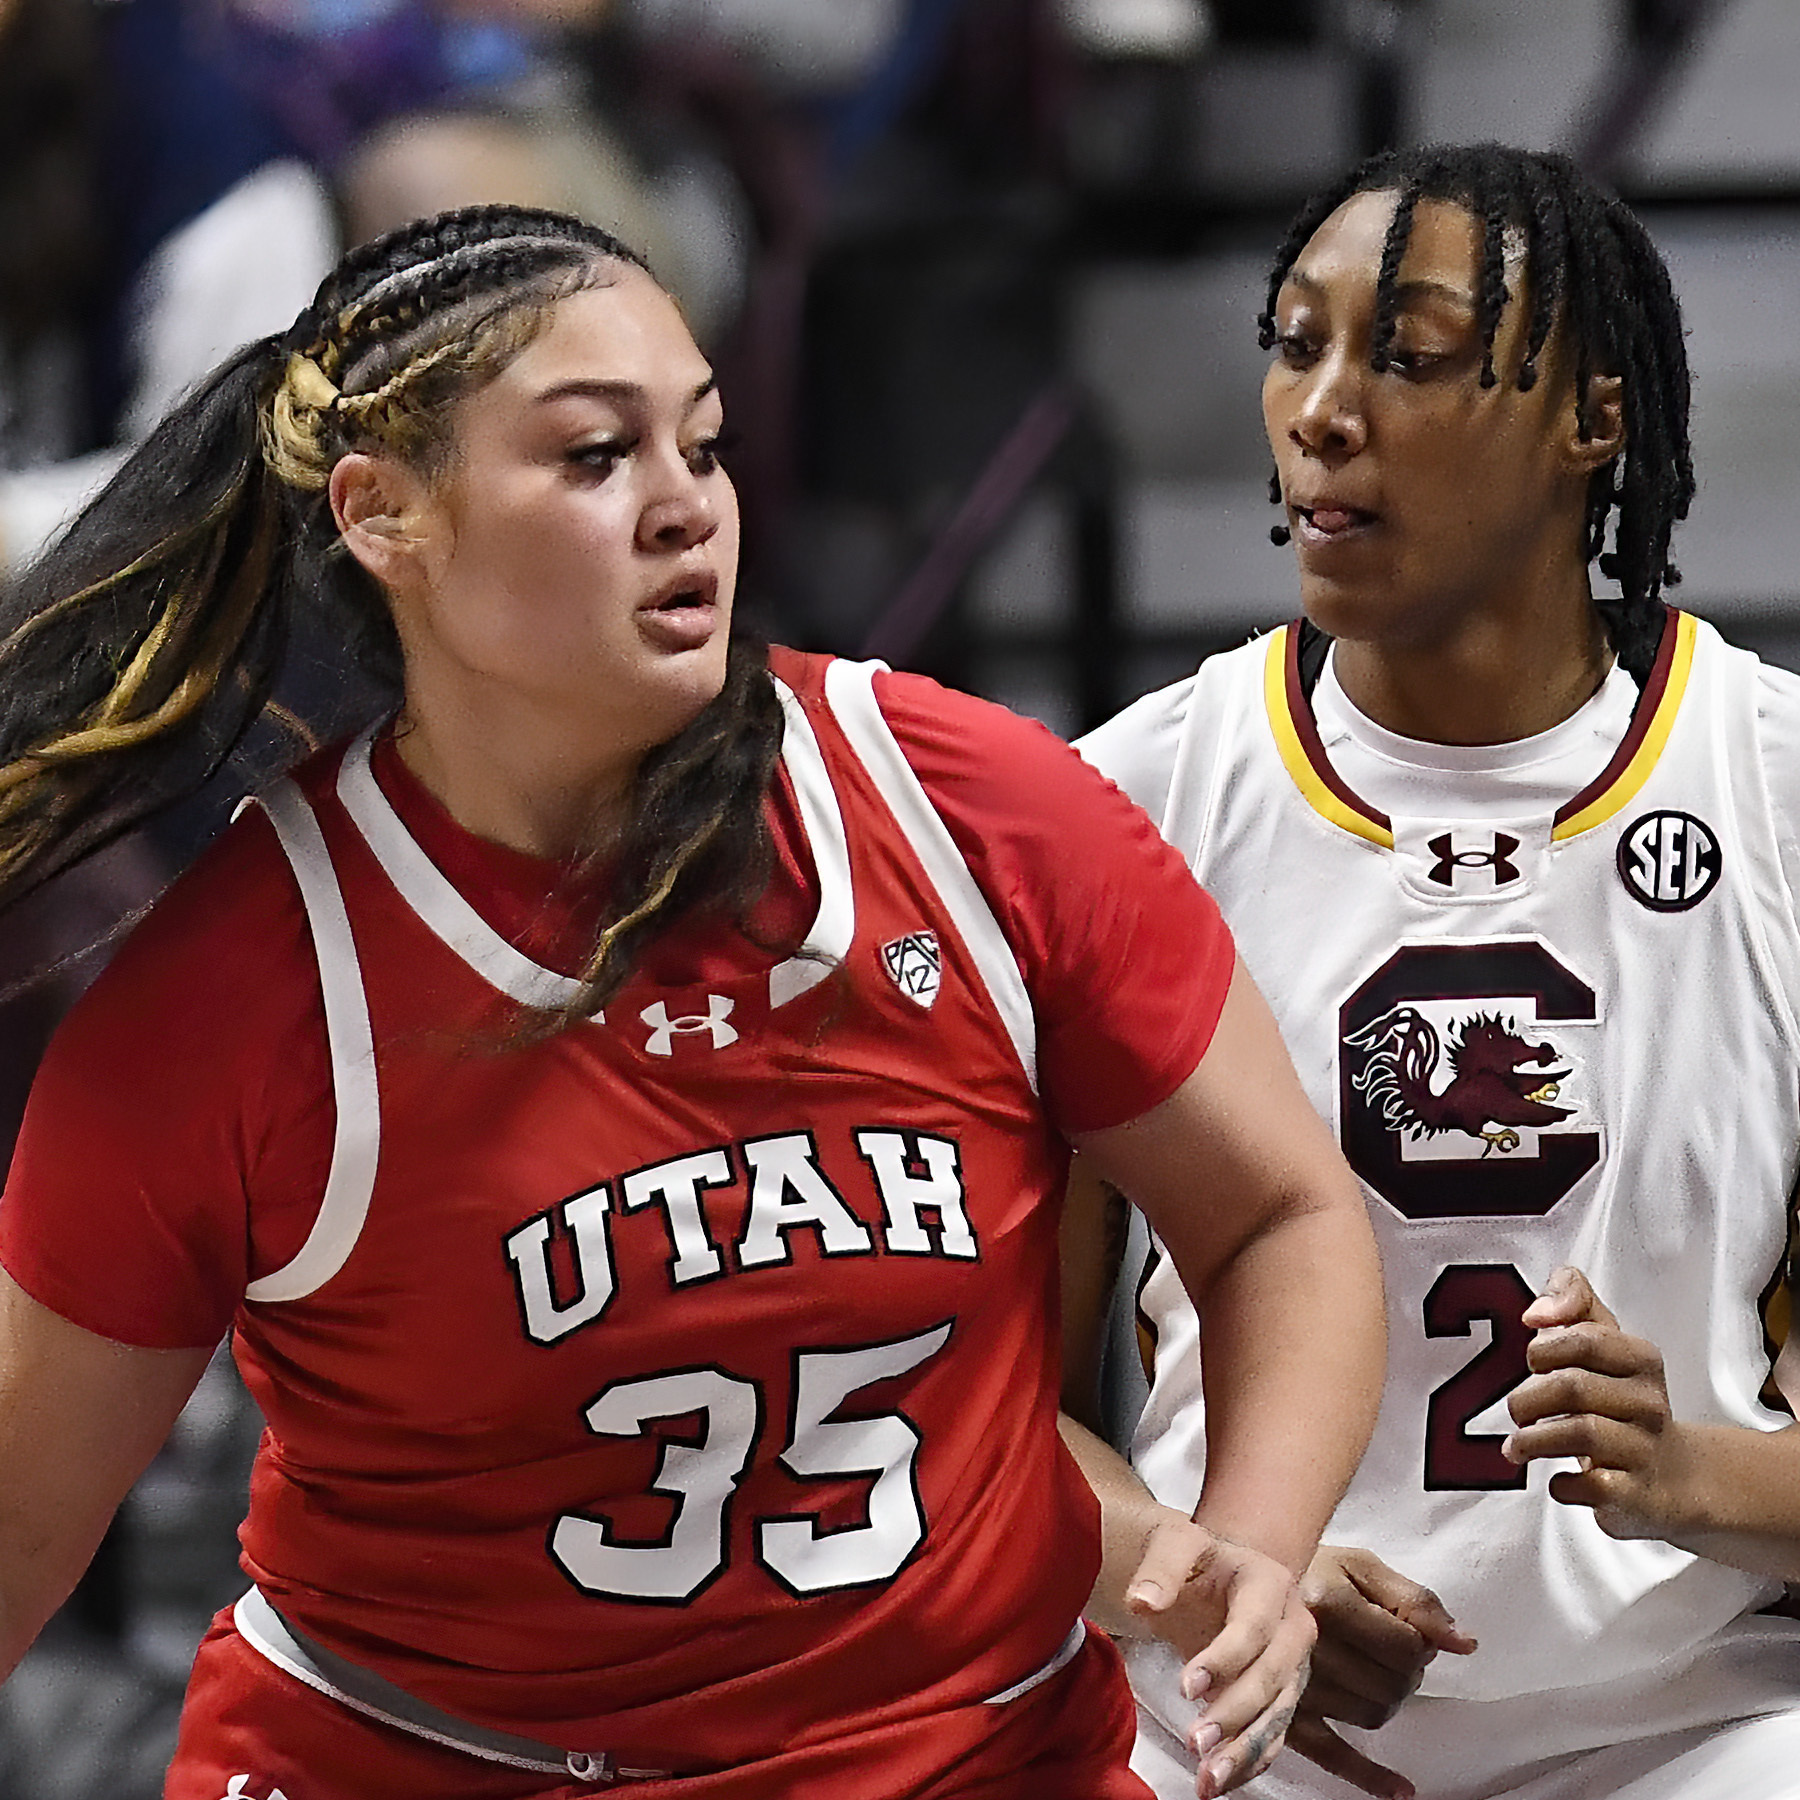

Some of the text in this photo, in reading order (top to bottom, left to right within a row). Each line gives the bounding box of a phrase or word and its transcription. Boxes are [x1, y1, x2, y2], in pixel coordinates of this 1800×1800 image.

[1627, 815, 1713, 901] SEC
[883, 932, 940, 982] PAC
[905, 964, 937, 996] 12
[503, 1126, 980, 1347] UTAH
[1422, 1263, 1541, 1492] 2
[546, 1314, 956, 1607] 35
